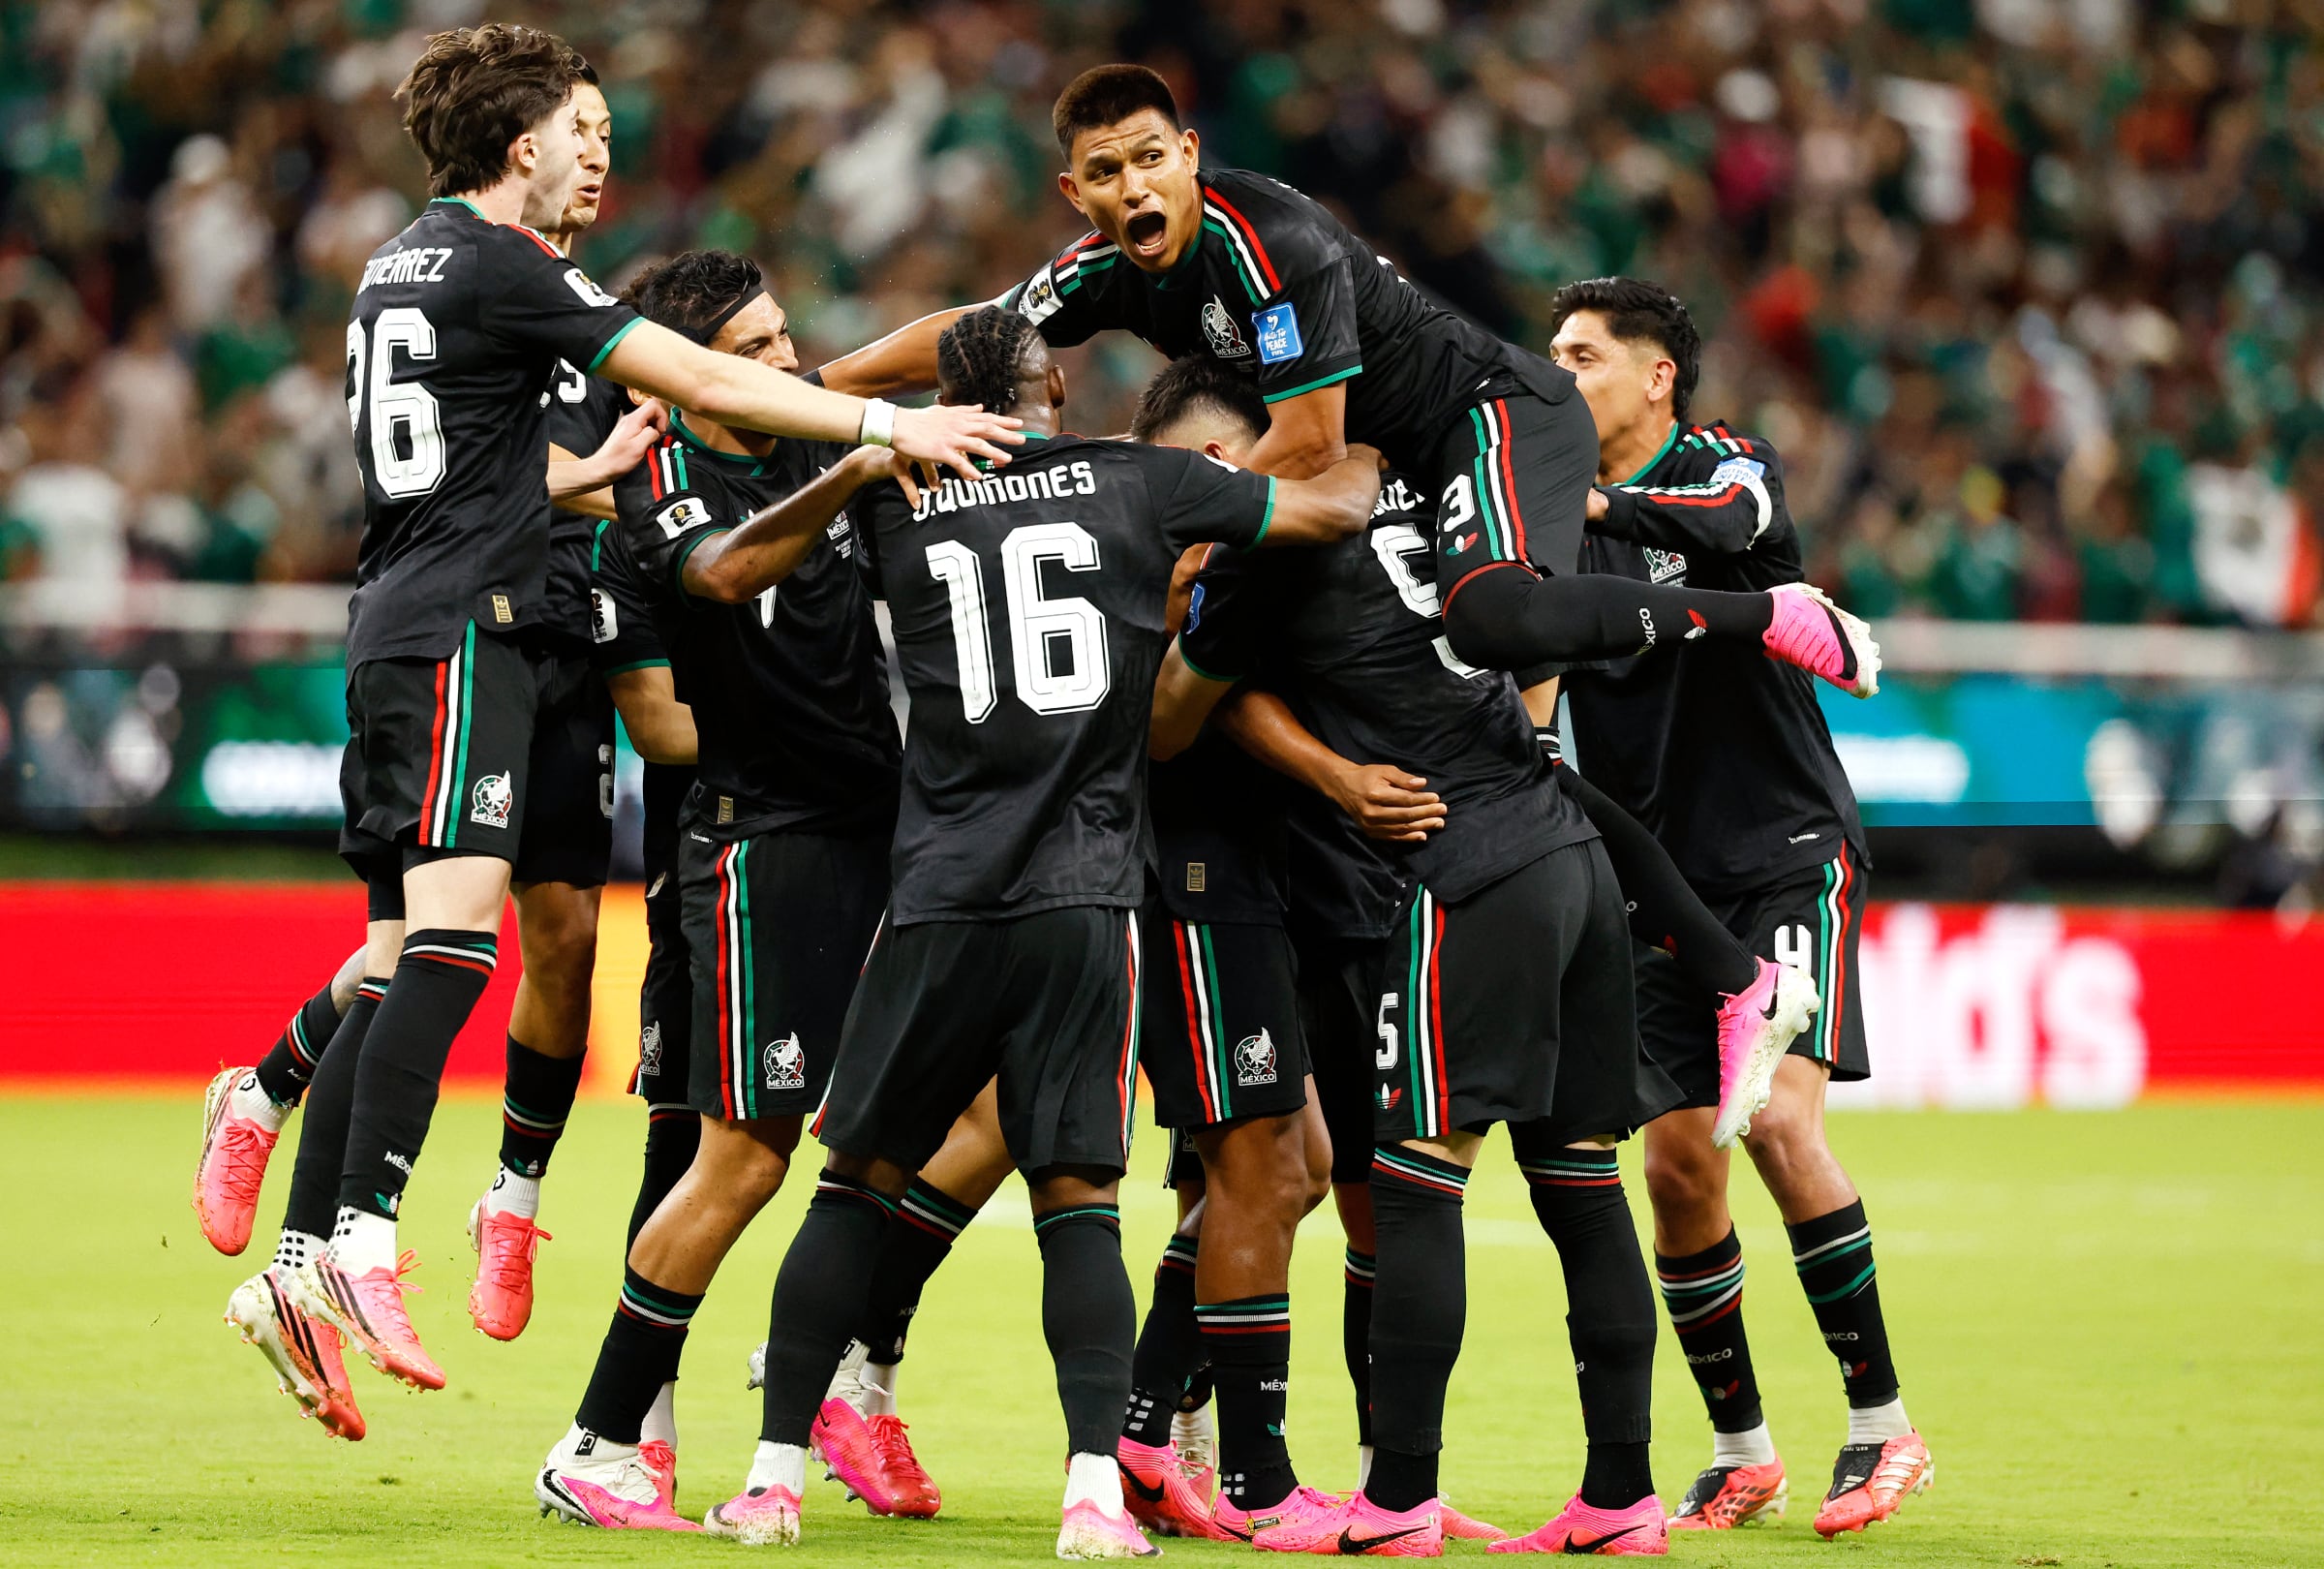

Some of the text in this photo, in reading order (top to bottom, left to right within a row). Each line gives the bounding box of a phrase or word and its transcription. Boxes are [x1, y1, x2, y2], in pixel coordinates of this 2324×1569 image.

[1266, 337, 1288, 352] PEACE
[1437, 475, 1476, 533] 3
[1651, 560, 1684, 580] MÉXICO
[925, 521, 1111, 724] 16
[1851, 899, 2149, 1111] ld's
[1376, 992, 1398, 1069] 5
[768, 1077, 803, 1088] MÉXICO
[1240, 1073, 1275, 1085] MÉXICO
